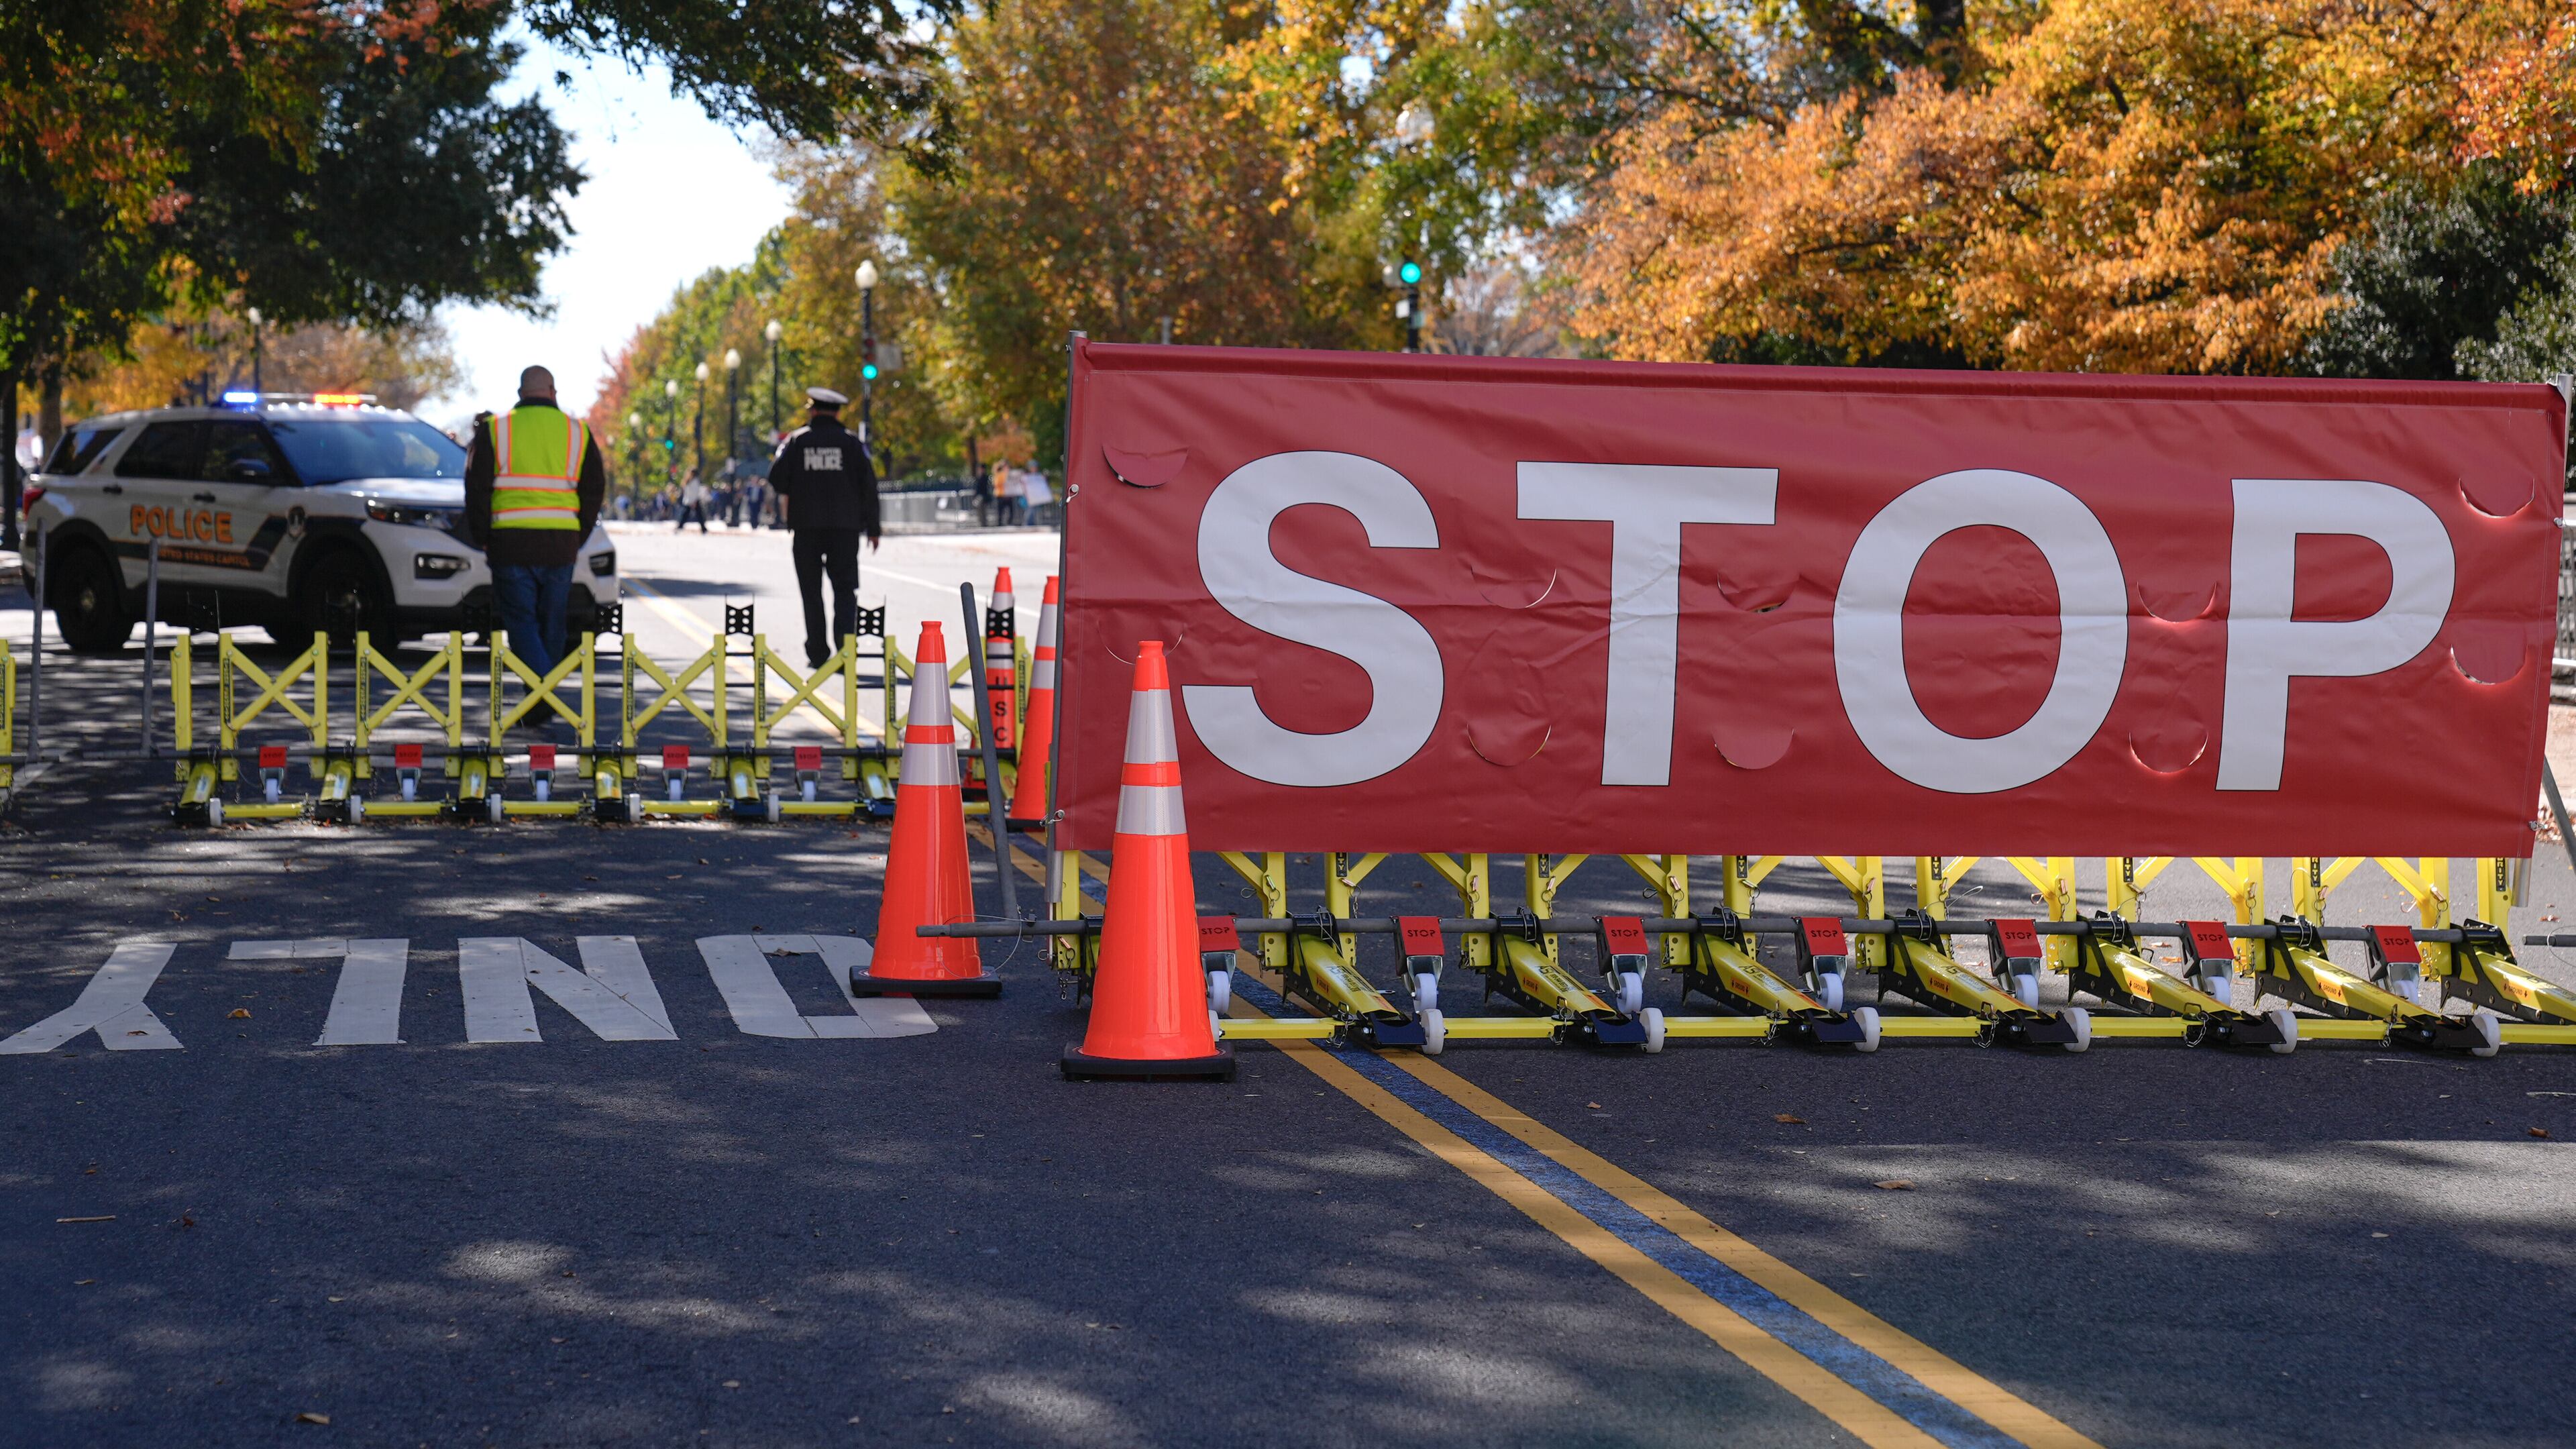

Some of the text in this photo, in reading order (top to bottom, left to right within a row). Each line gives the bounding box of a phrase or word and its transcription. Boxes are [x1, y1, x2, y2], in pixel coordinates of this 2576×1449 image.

[804, 456, 844, 472] POLICE
[130, 504, 234, 544] POLICE
[1181, 451, 2456, 794] STOP
[1407, 929, 1436, 937] STOP
[1611, 928, 1639, 938] STOP
[1810, 928, 1838, 938] STOP
[2004, 931, 2032, 940] STOP
[2197, 932, 2224, 942] STOP
[2383, 936, 2410, 946] STOP
[1933, 979, 1945, 990] GROUND
[2133, 982, 2147, 993] GROUND
[2323, 984, 2337, 996] GROUND
